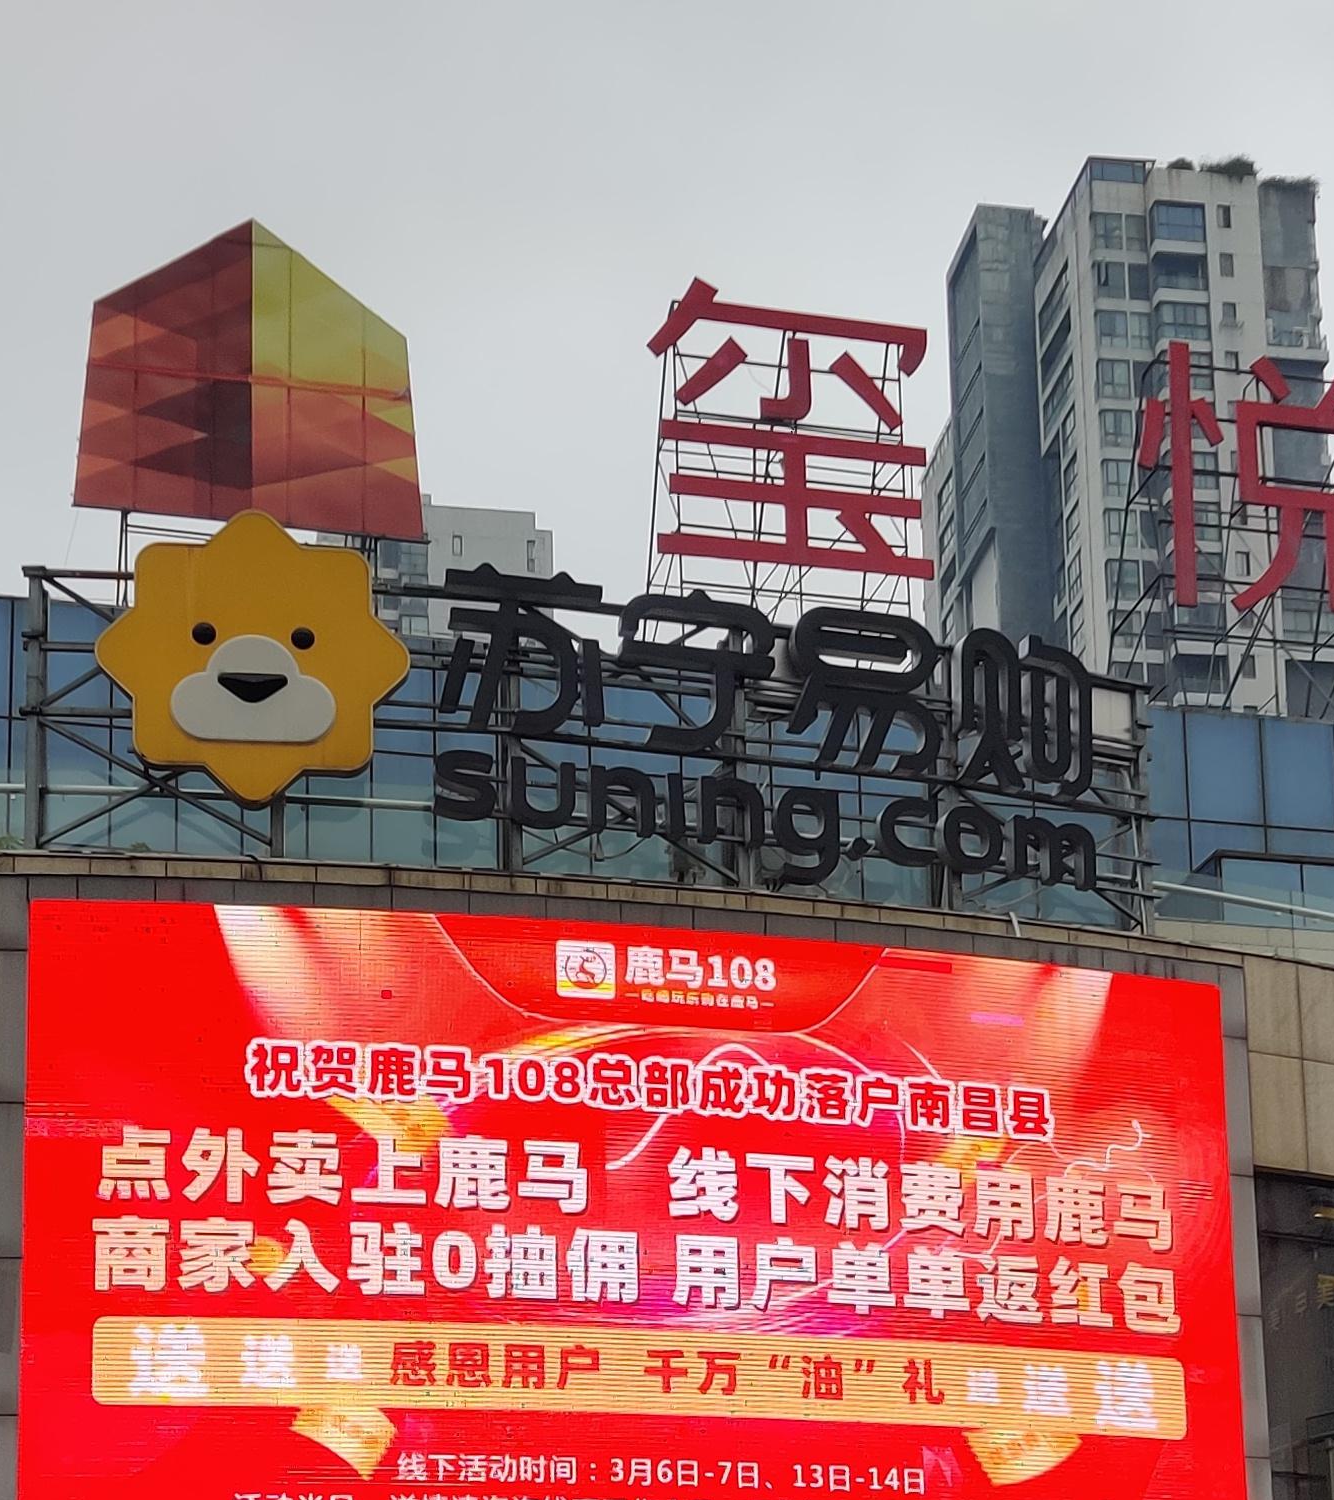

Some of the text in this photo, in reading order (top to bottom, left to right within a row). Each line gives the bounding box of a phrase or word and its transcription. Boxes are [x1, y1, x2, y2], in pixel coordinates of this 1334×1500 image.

[434, 751, 1097, 893] suning.com
[623, 945, 777, 992] 鹿马108
[245, 1037, 1055, 1141] 祝贺鹿马108总部成功落户南昌县
[100, 1126, 1174, 1253] 点外卖上鹿马 线下消费用鹿马
[92, 1216, 1182, 1335] 商家入驻0抽佣 用户单单返红包
[390, 1341, 601, 1390] 感恩用户
